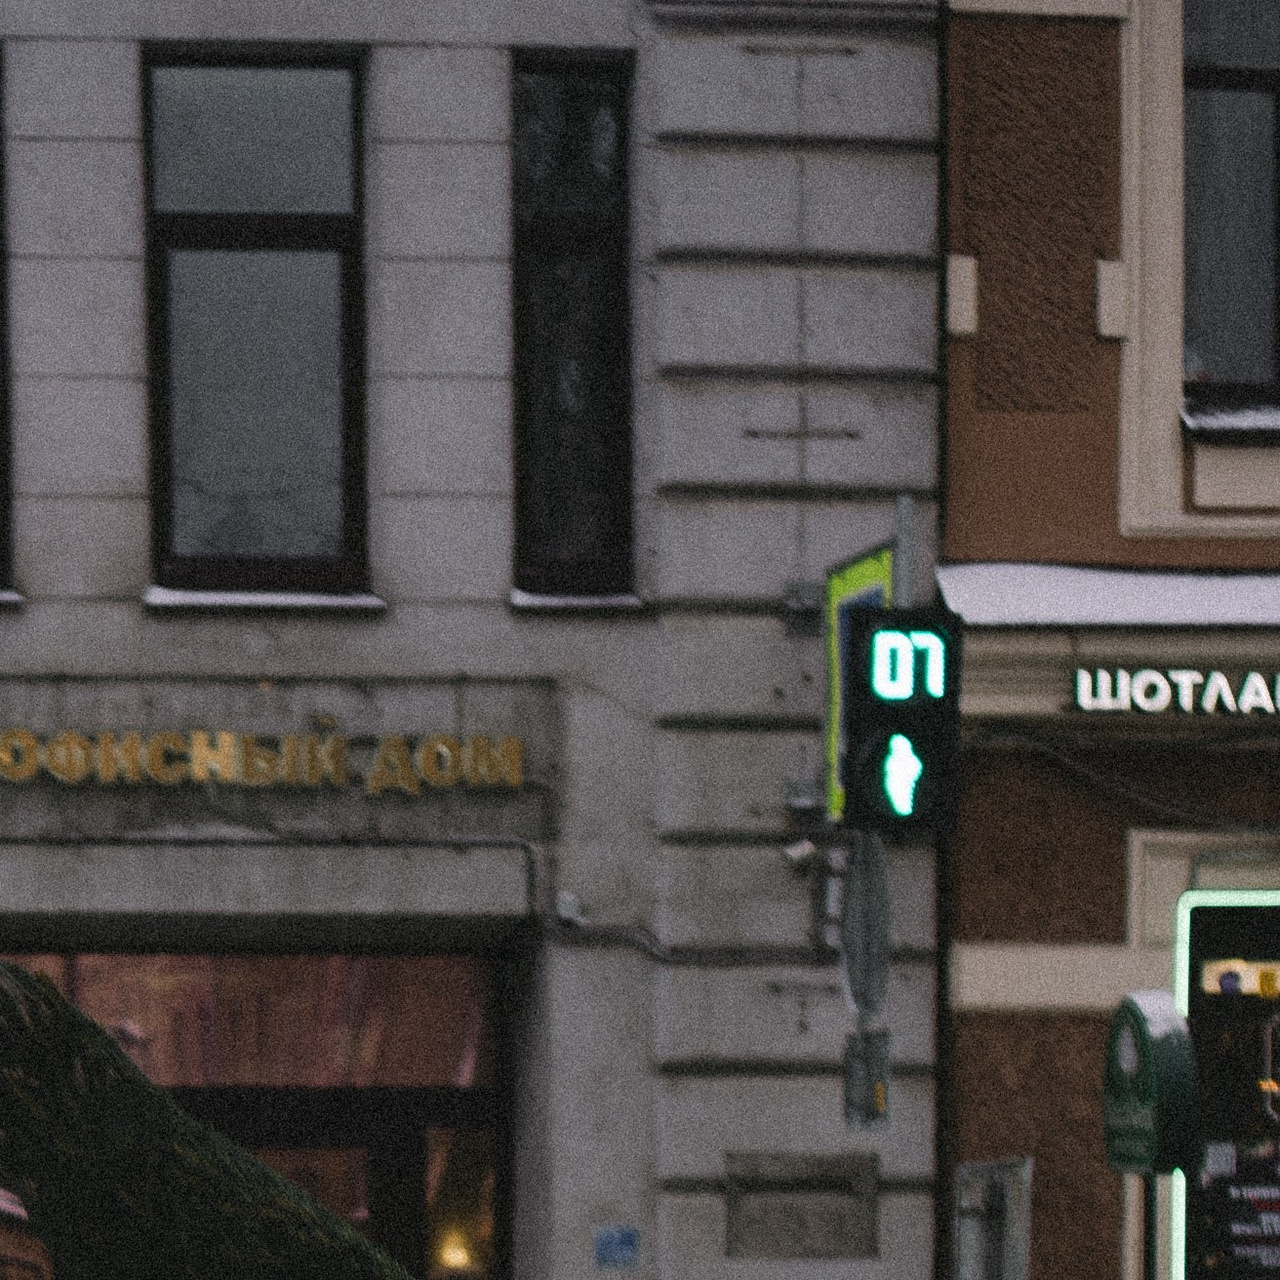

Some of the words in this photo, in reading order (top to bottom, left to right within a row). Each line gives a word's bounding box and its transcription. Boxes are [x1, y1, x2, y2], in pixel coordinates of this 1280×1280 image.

[871, 629, 946, 701] 07
[1076, 667, 1280, 714] ШОТЛА
[367, 735, 526, 796] ДОМ
